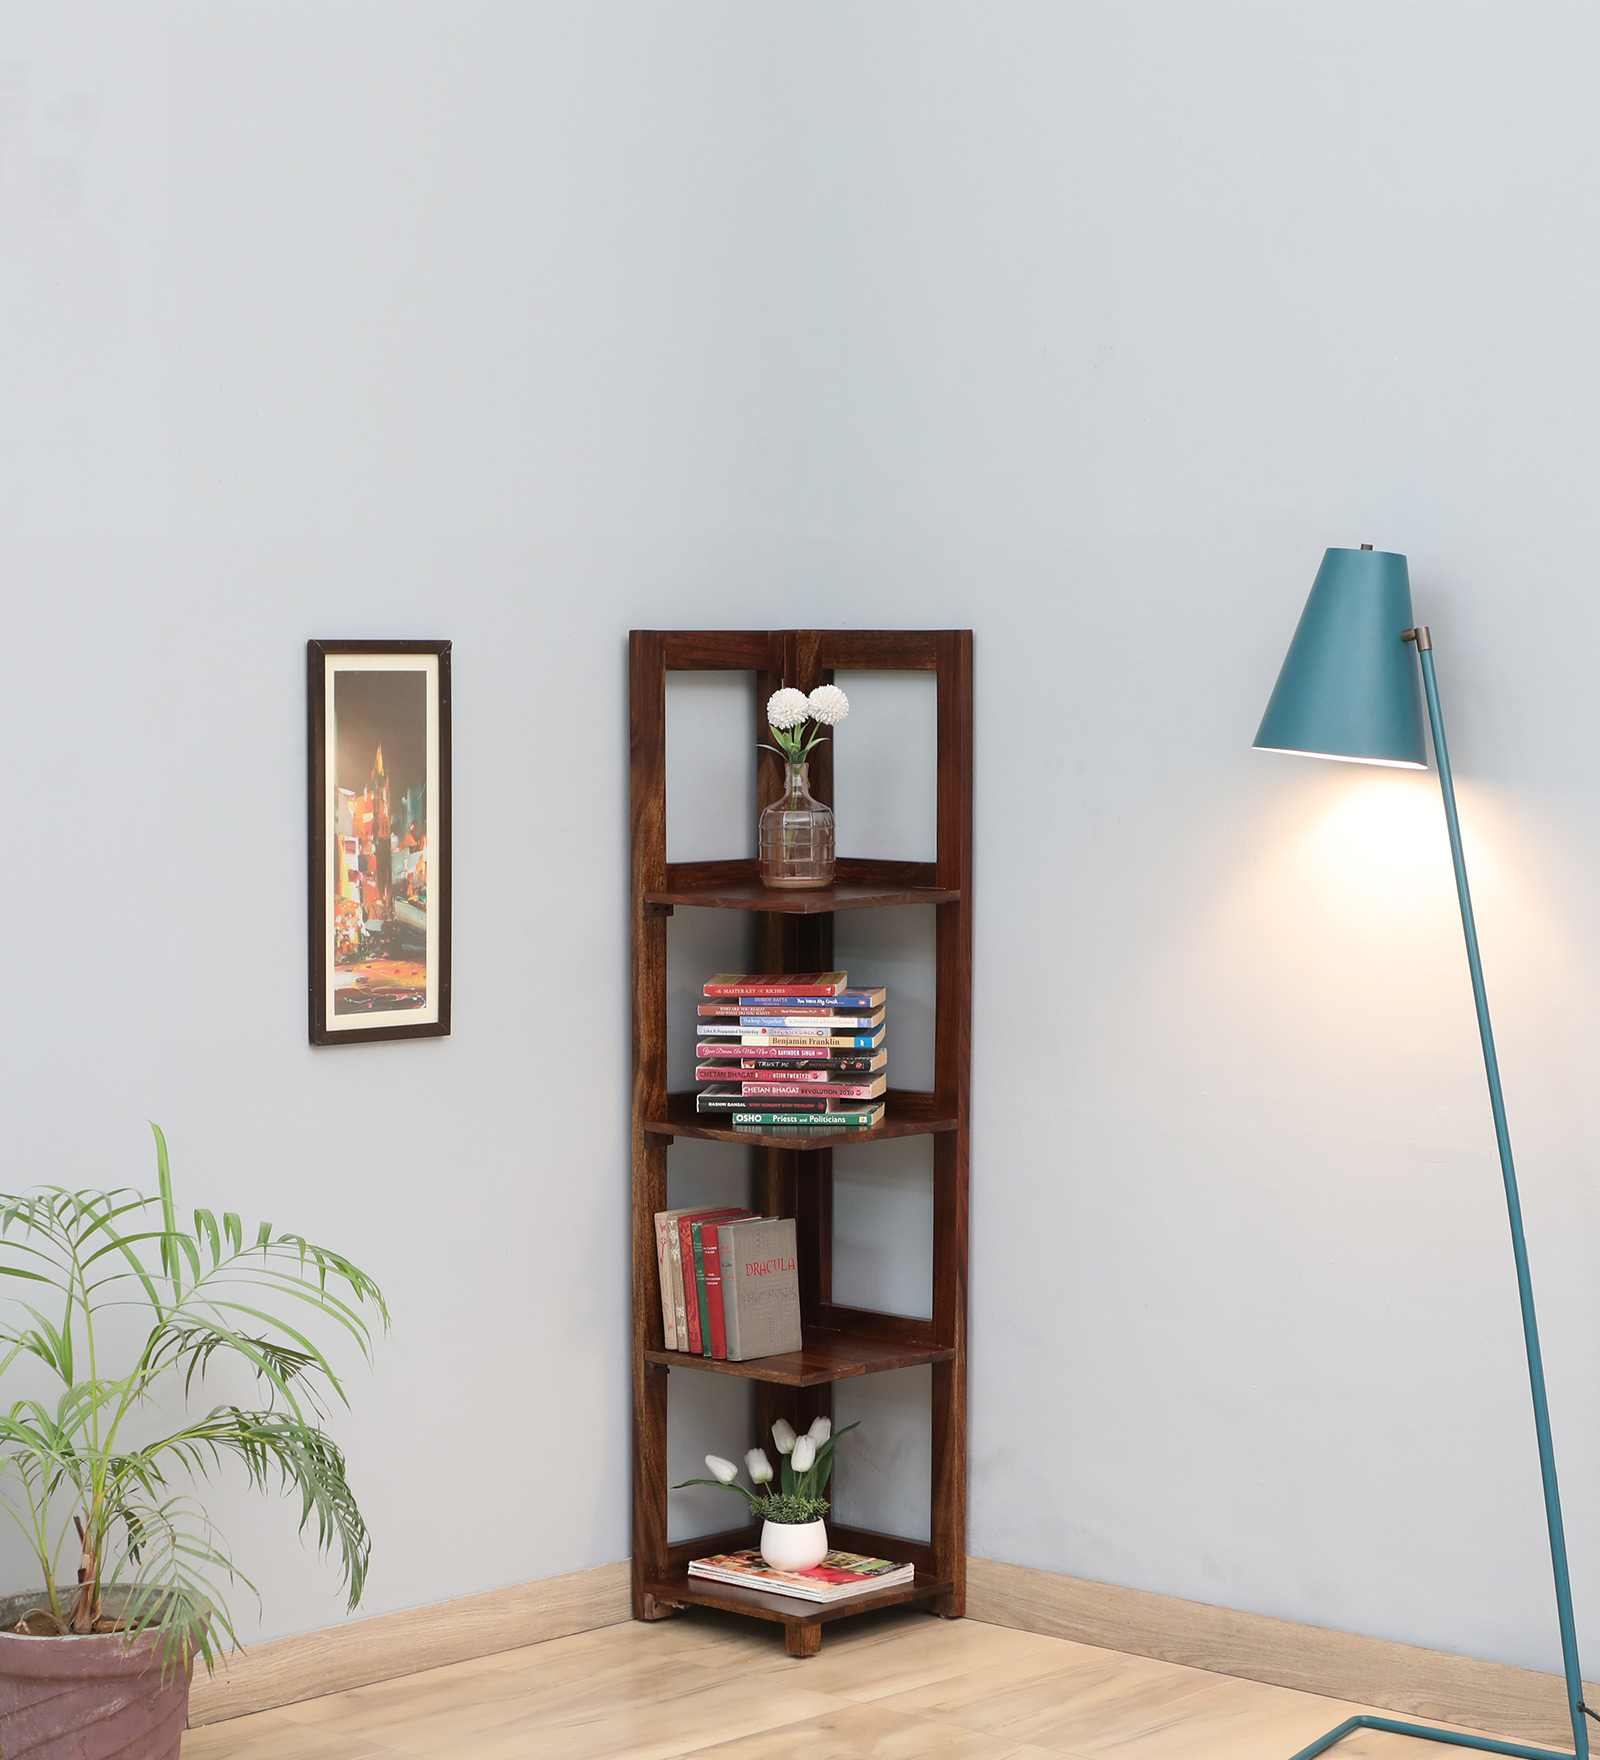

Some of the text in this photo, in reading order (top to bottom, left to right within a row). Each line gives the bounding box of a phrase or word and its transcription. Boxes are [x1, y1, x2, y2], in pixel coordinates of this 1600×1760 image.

[772, 1037, 840, 1046] Benjamin Franklin
[699, 1070, 754, 1078] CHETAN BHAGAT
[743, 1086, 771, 1094] CHETAN
[772, 1086, 800, 1094] BHAGAT
[801, 1088, 838, 1096] REVOLUTION
[736, 1114, 763, 1123] OSHO
[772, 1114, 798, 1123] Priests
[809, 1115, 846, 1123] Politicians
[745, 1257, 797, 1278] DRACULA
